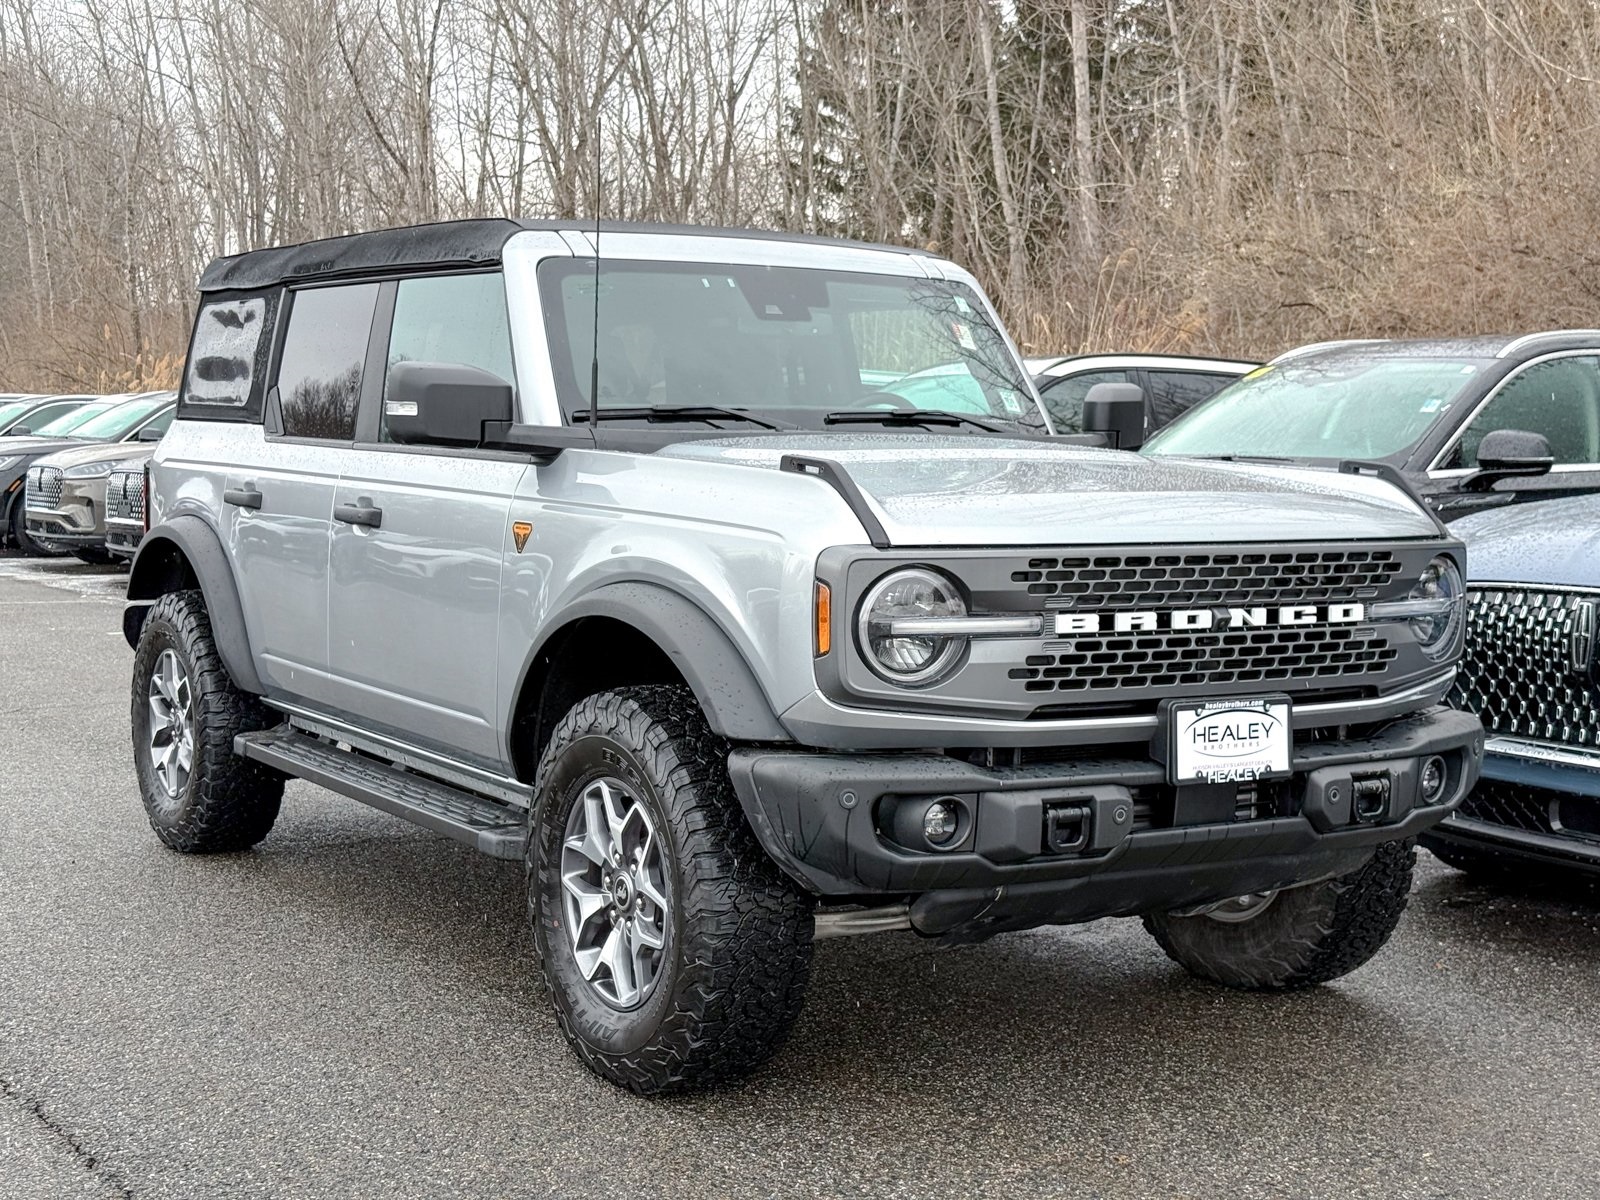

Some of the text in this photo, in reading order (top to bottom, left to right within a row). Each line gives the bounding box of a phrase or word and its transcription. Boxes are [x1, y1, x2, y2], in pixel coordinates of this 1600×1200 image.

[1055, 603, 1364, 634] BRONCO
[1204, 700, 1264, 710] healeybrothers.com
[1193, 722, 1274, 743] HEALEY
[1203, 741, 1260, 751] BROTHERS
[1207, 767, 1261, 784] HEALEY
